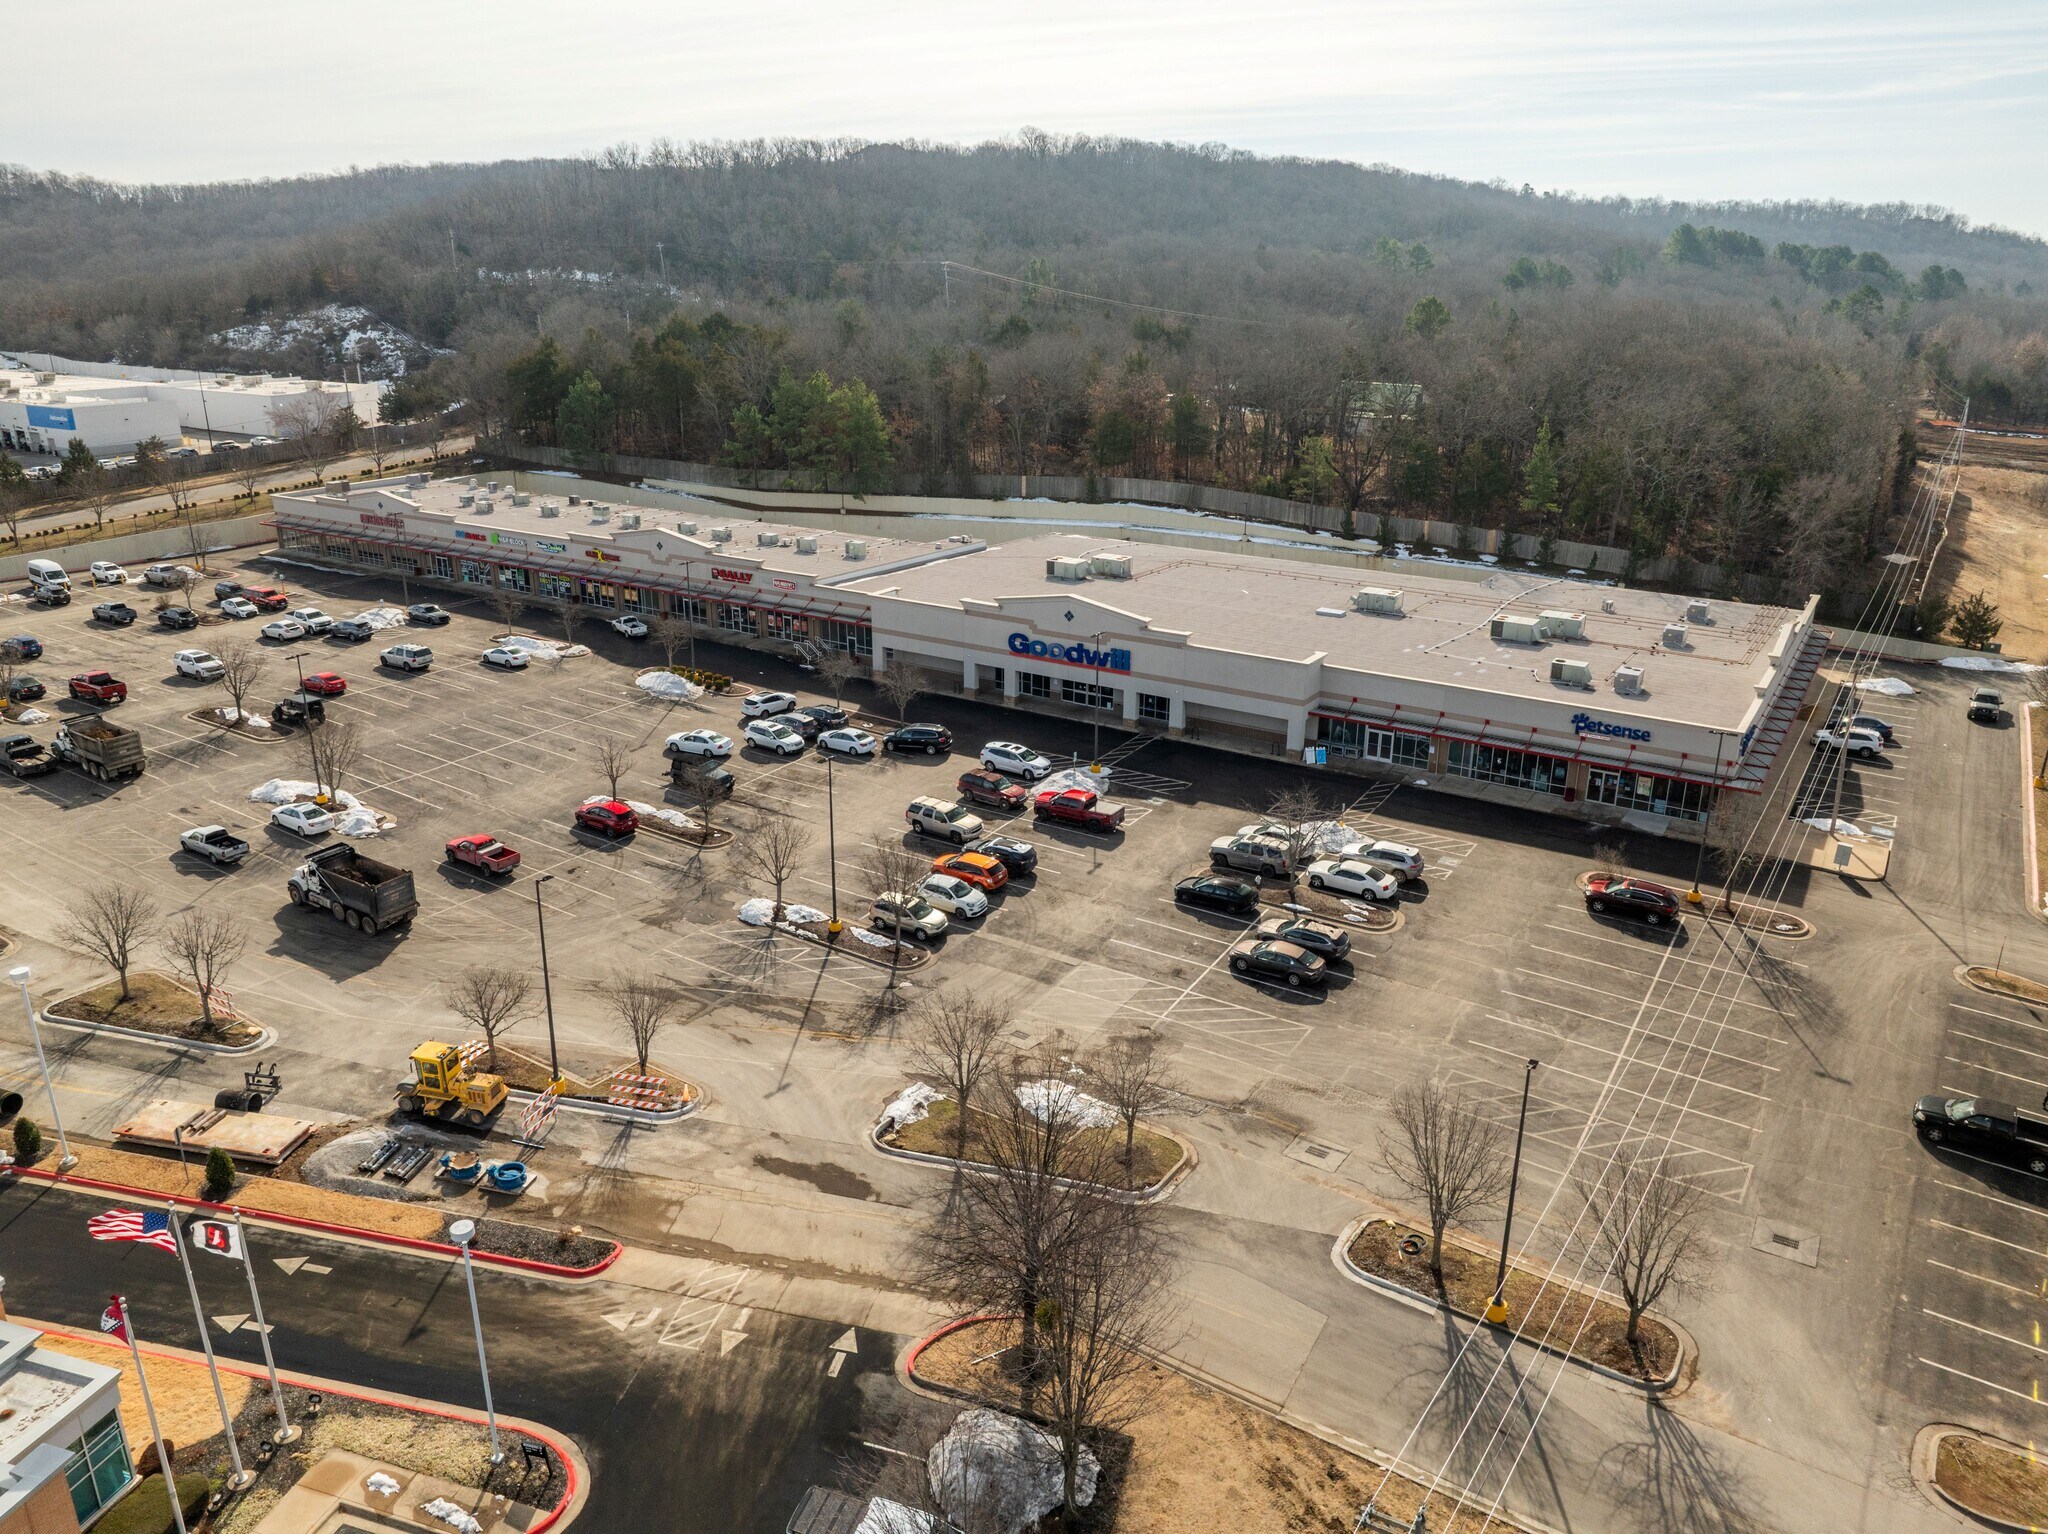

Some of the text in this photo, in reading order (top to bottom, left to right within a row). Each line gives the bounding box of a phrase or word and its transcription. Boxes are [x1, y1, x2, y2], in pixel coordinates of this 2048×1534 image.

[719, 569, 753, 582] SALLY
[1008, 632, 1131, 672] Goodwill
[1574, 718, 1651, 742] petsense
